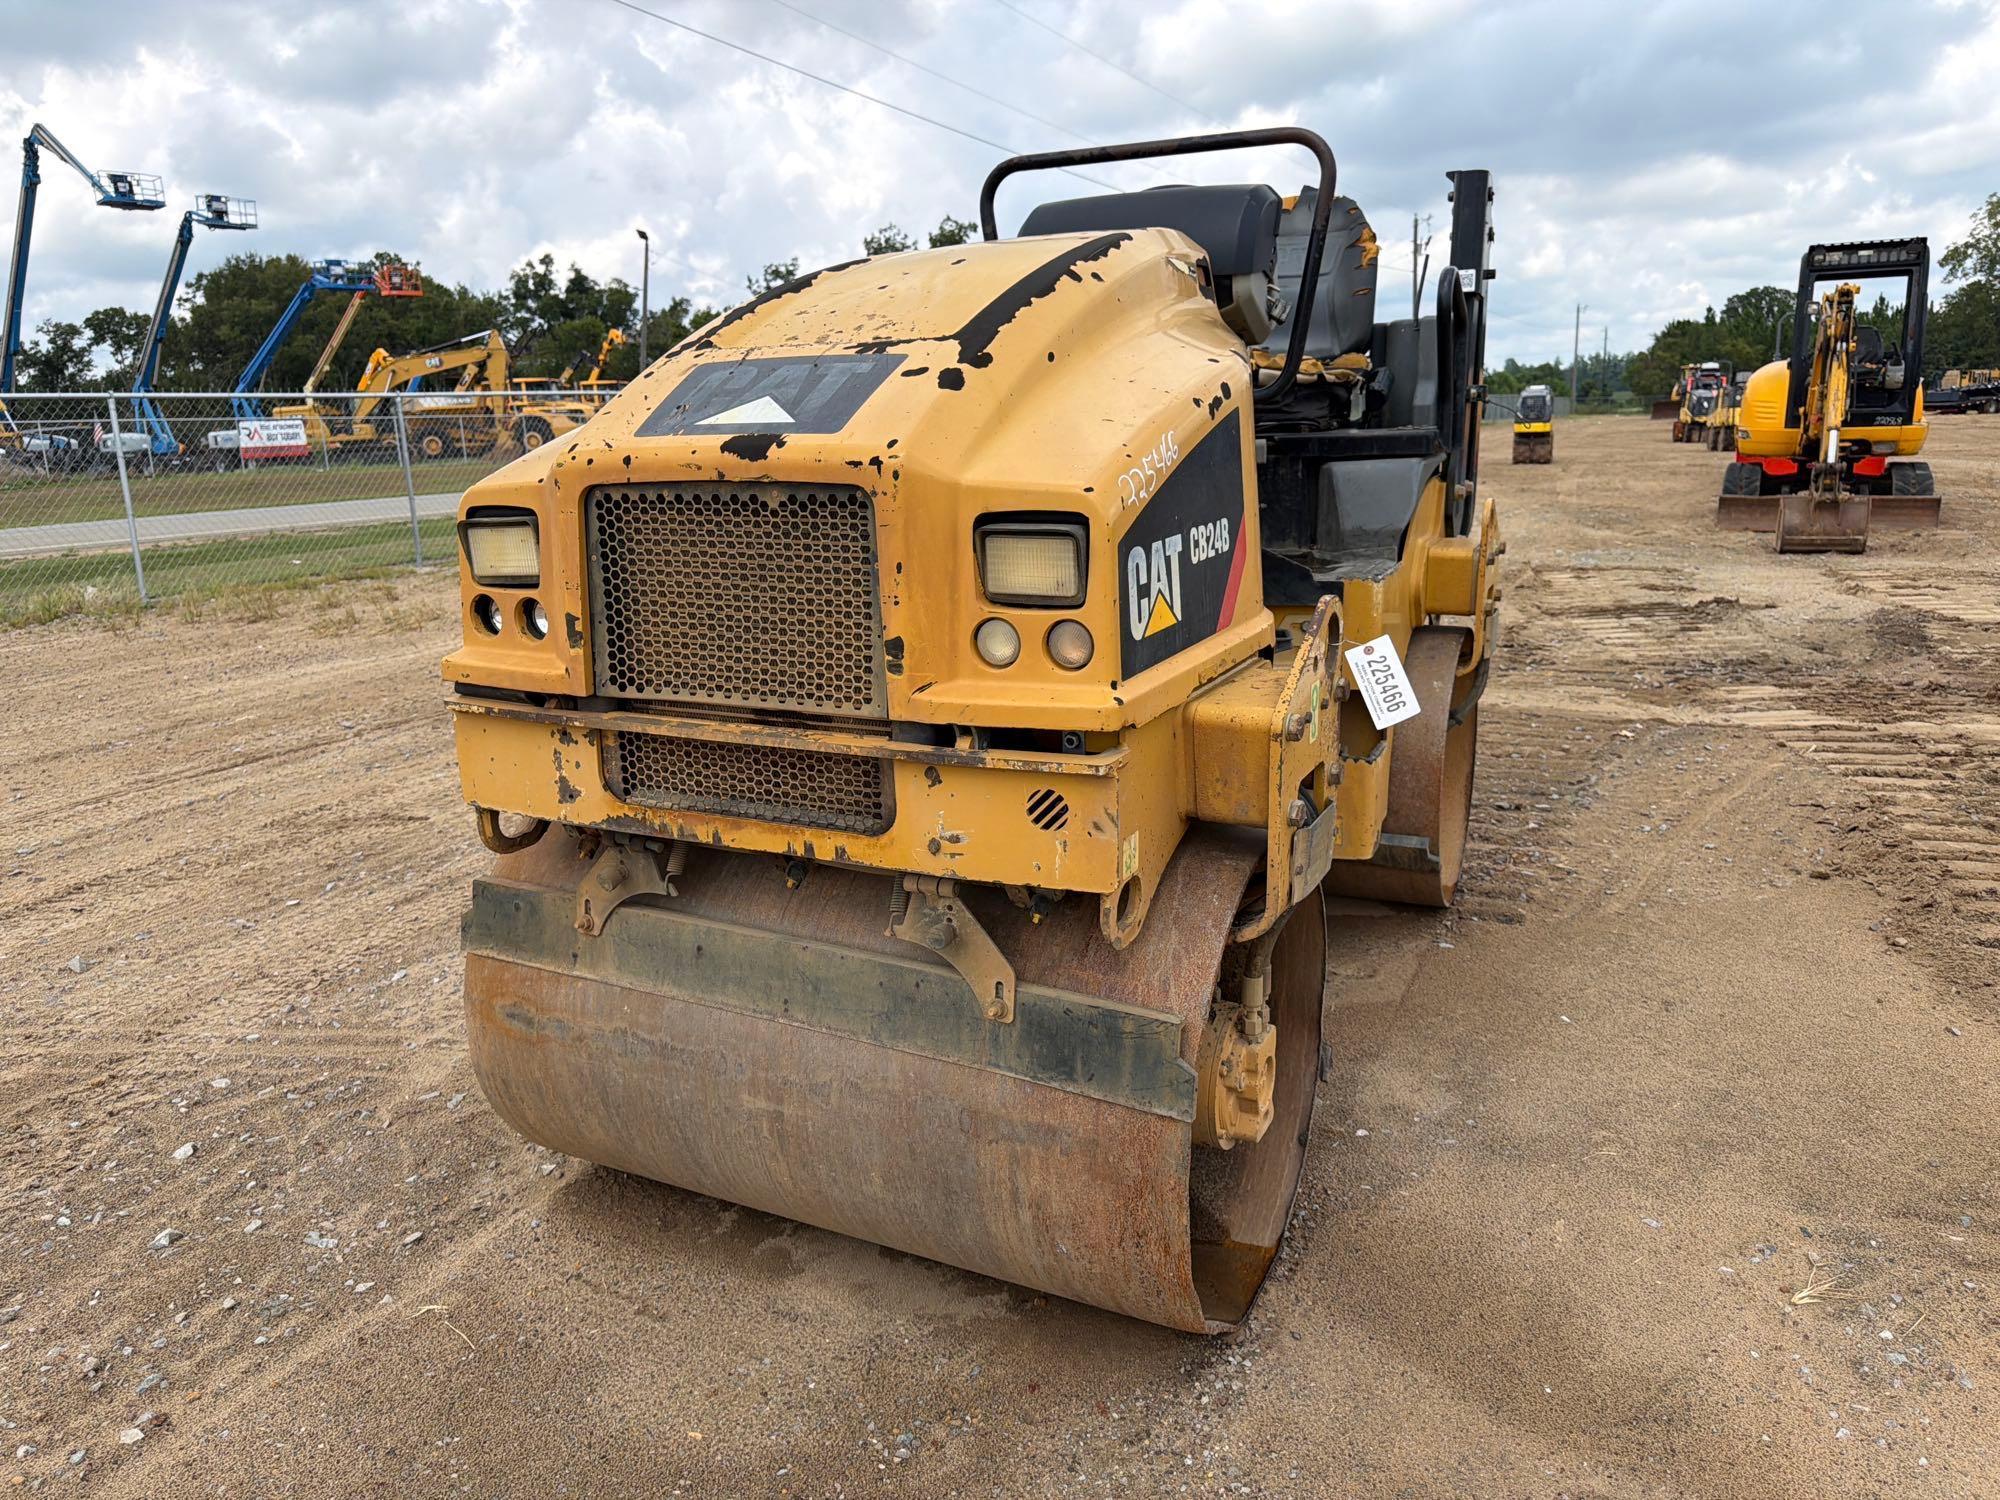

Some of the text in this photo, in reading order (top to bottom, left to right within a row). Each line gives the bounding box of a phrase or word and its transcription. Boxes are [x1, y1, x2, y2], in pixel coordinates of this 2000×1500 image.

[1117, 430, 1179, 506] 225466
[1189, 517, 1230, 564] CB24B
[1127, 533, 1182, 641] CAT
[1367, 655, 1407, 713] 225466
